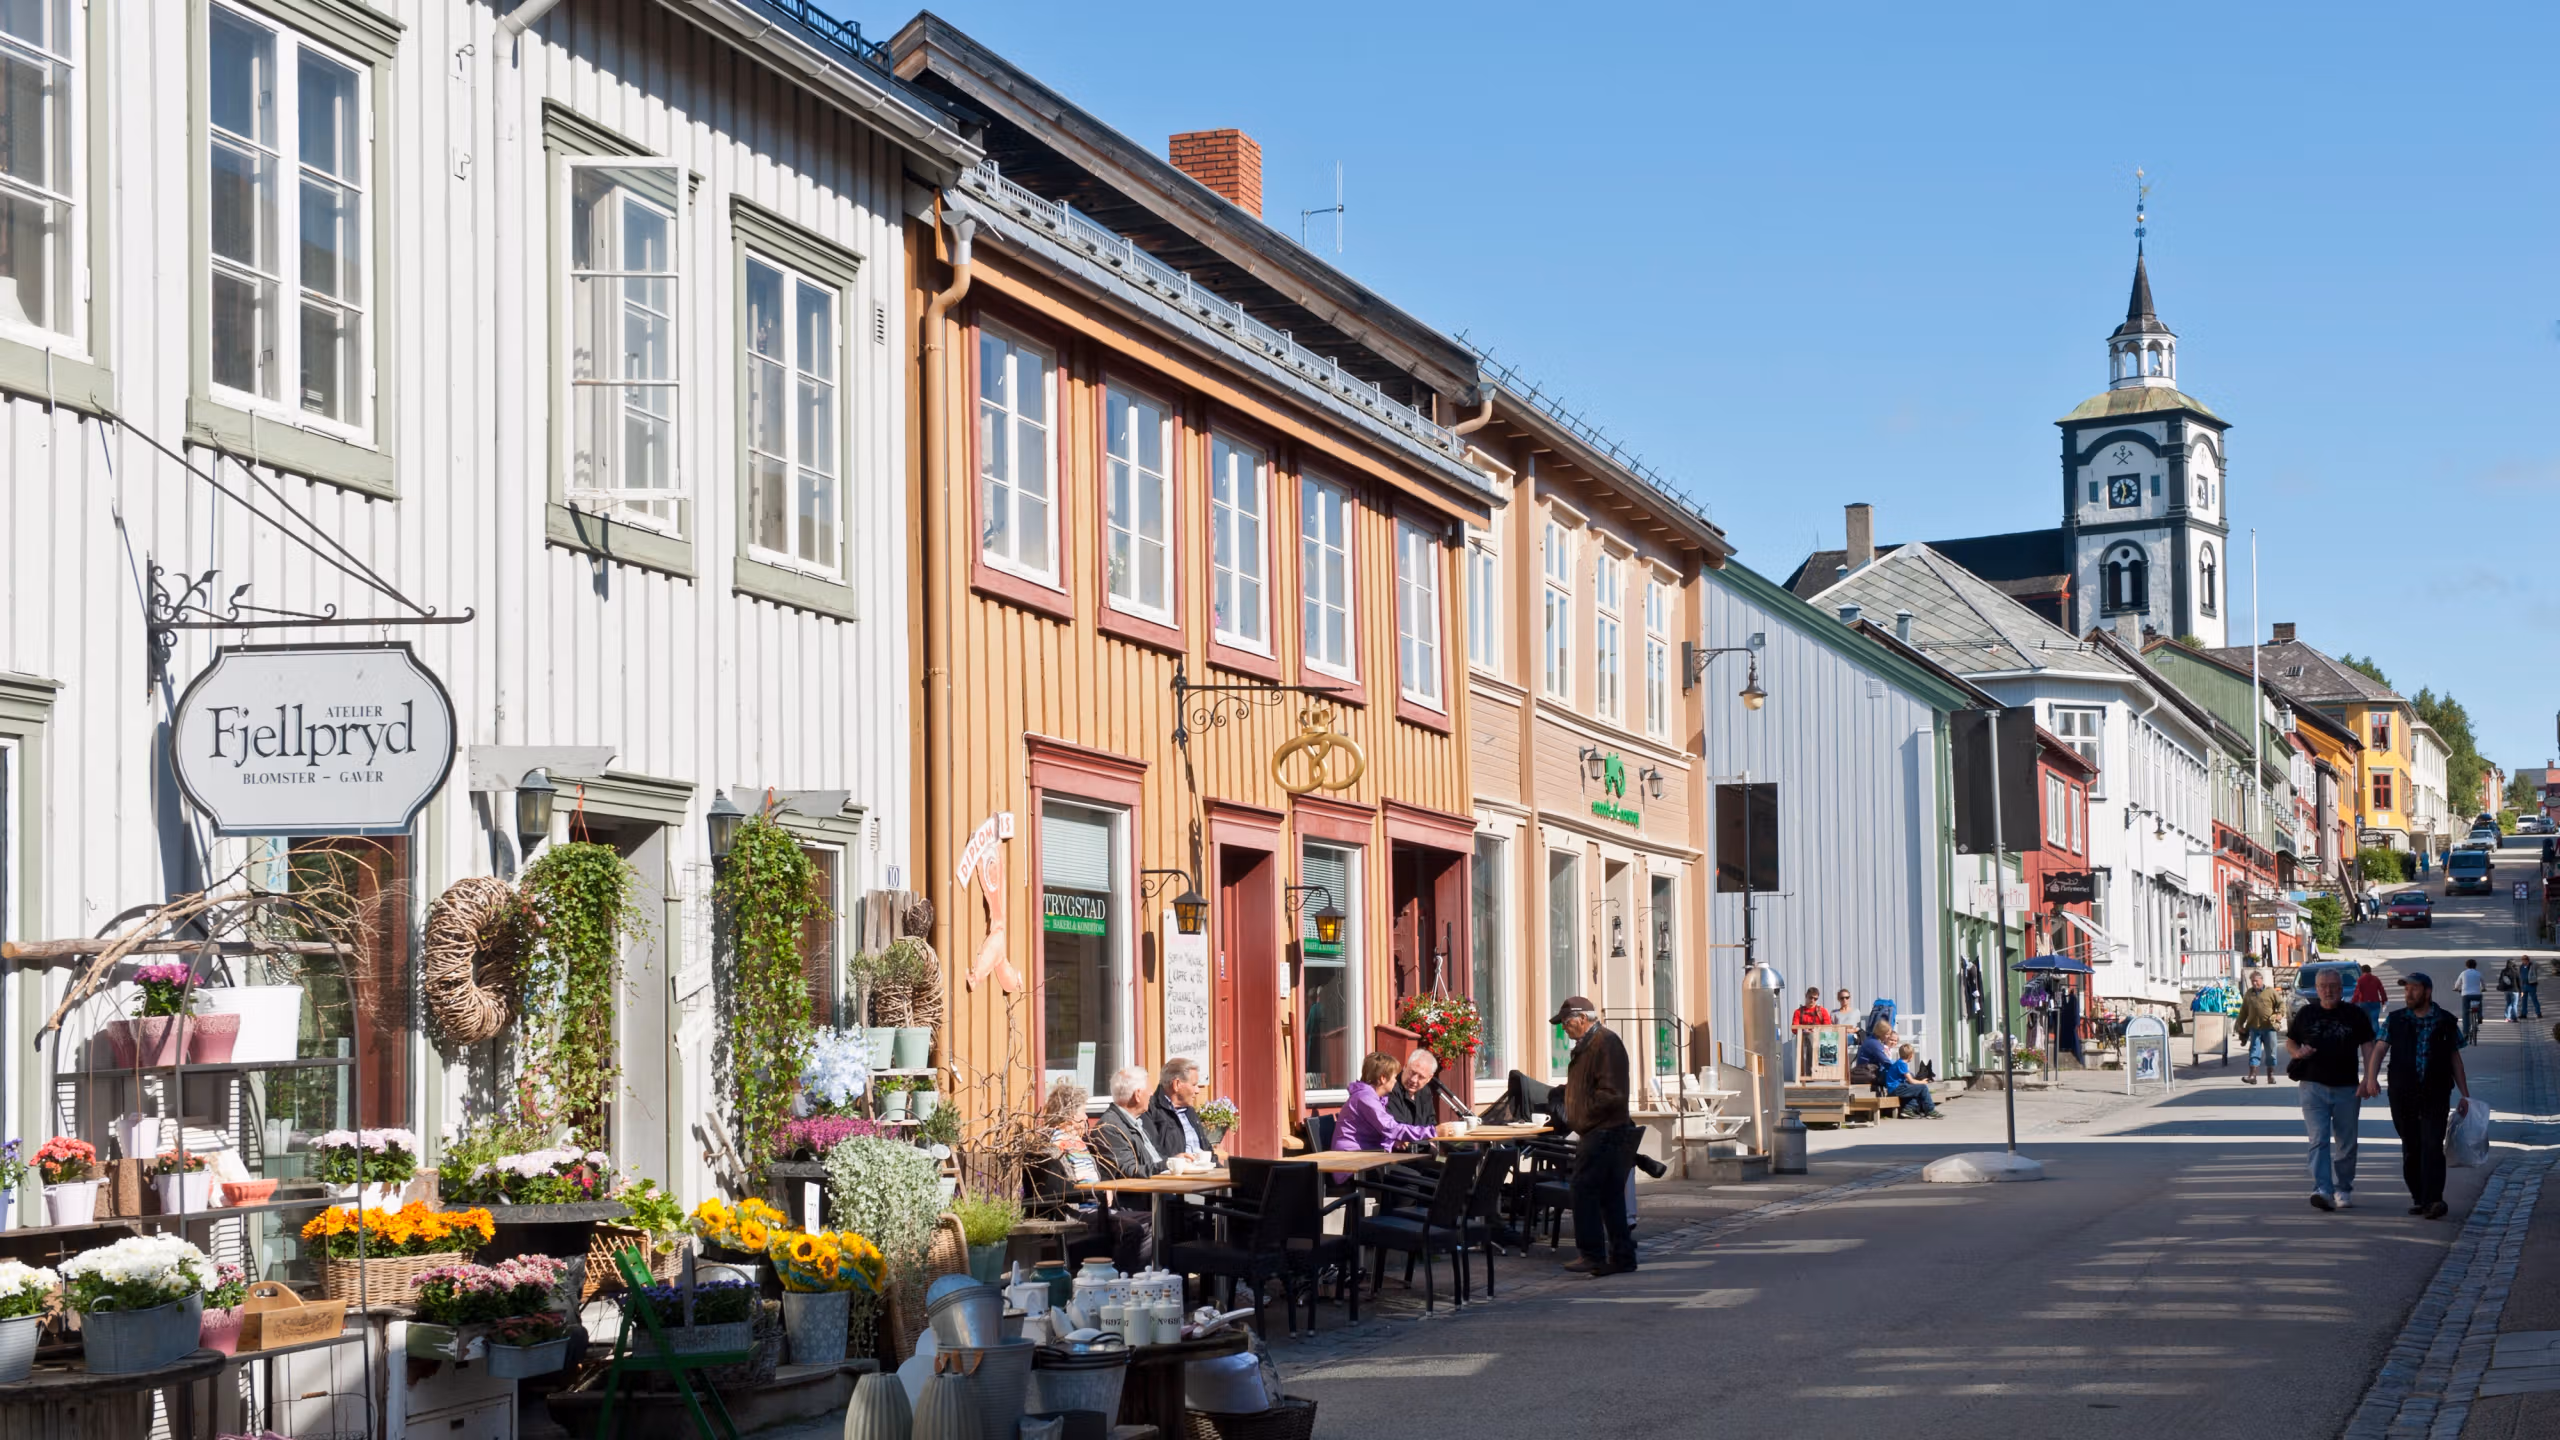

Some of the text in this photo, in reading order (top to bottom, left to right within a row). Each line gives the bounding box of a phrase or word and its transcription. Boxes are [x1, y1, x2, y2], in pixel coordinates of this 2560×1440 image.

[325, 705, 383, 718] ATELIER
[205, 698, 417, 768] Fjellpryd
[243, 772, 316, 785] BLOMSTER
[339, 770, 384, 783] GAVER
[960, 815, 1011, 879] DIPLOM IS
[889, 867, 898, 887] 10
[1043, 893, 1107, 921] TRYGSTAD
[1052, 919, 1072, 929] BAKERI
[1077, 920, 1105, 934] KONDITORI
